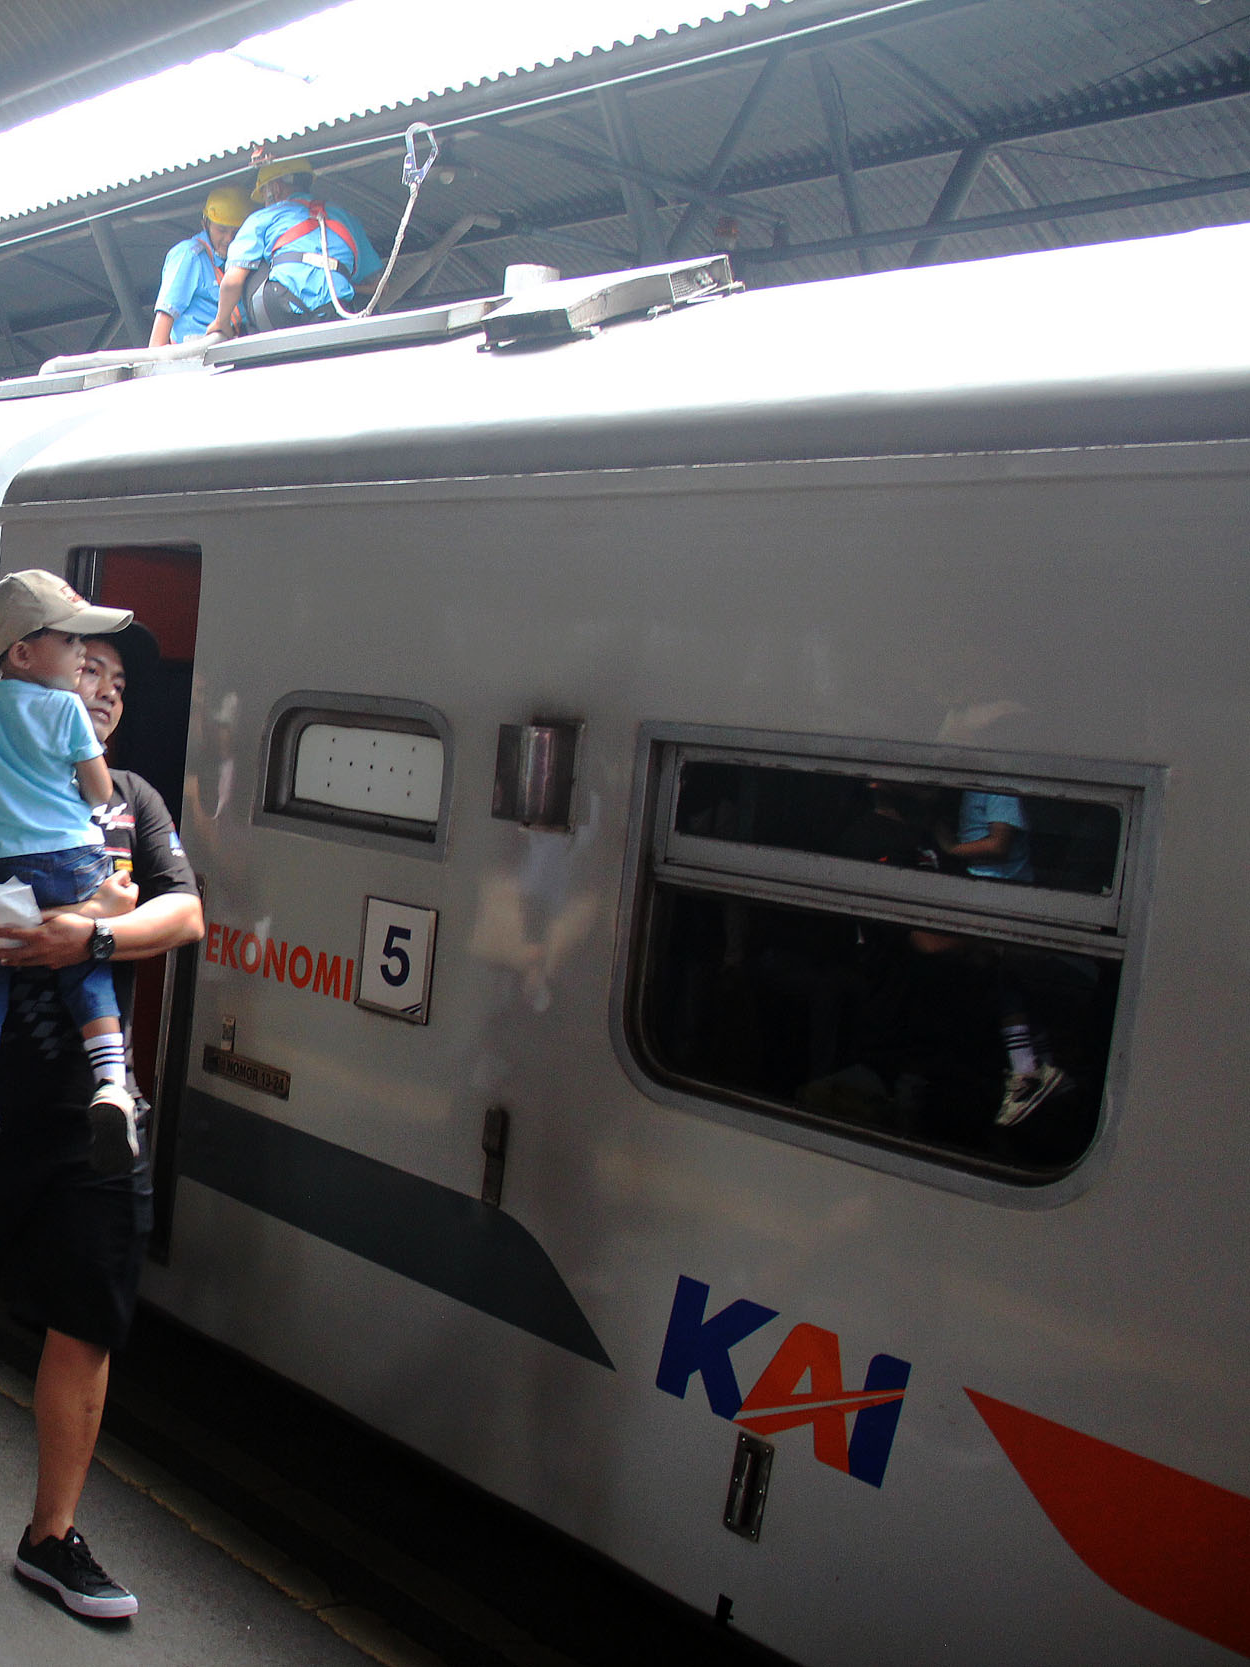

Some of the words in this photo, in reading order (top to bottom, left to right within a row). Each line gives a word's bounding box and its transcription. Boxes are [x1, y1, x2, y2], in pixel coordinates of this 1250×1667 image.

[206, 922, 354, 1002] EKONOMI
[380, 925, 412, 987] 5
[226, 1059, 258, 1084] NOMOR
[656, 1274, 912, 1489] KAI
